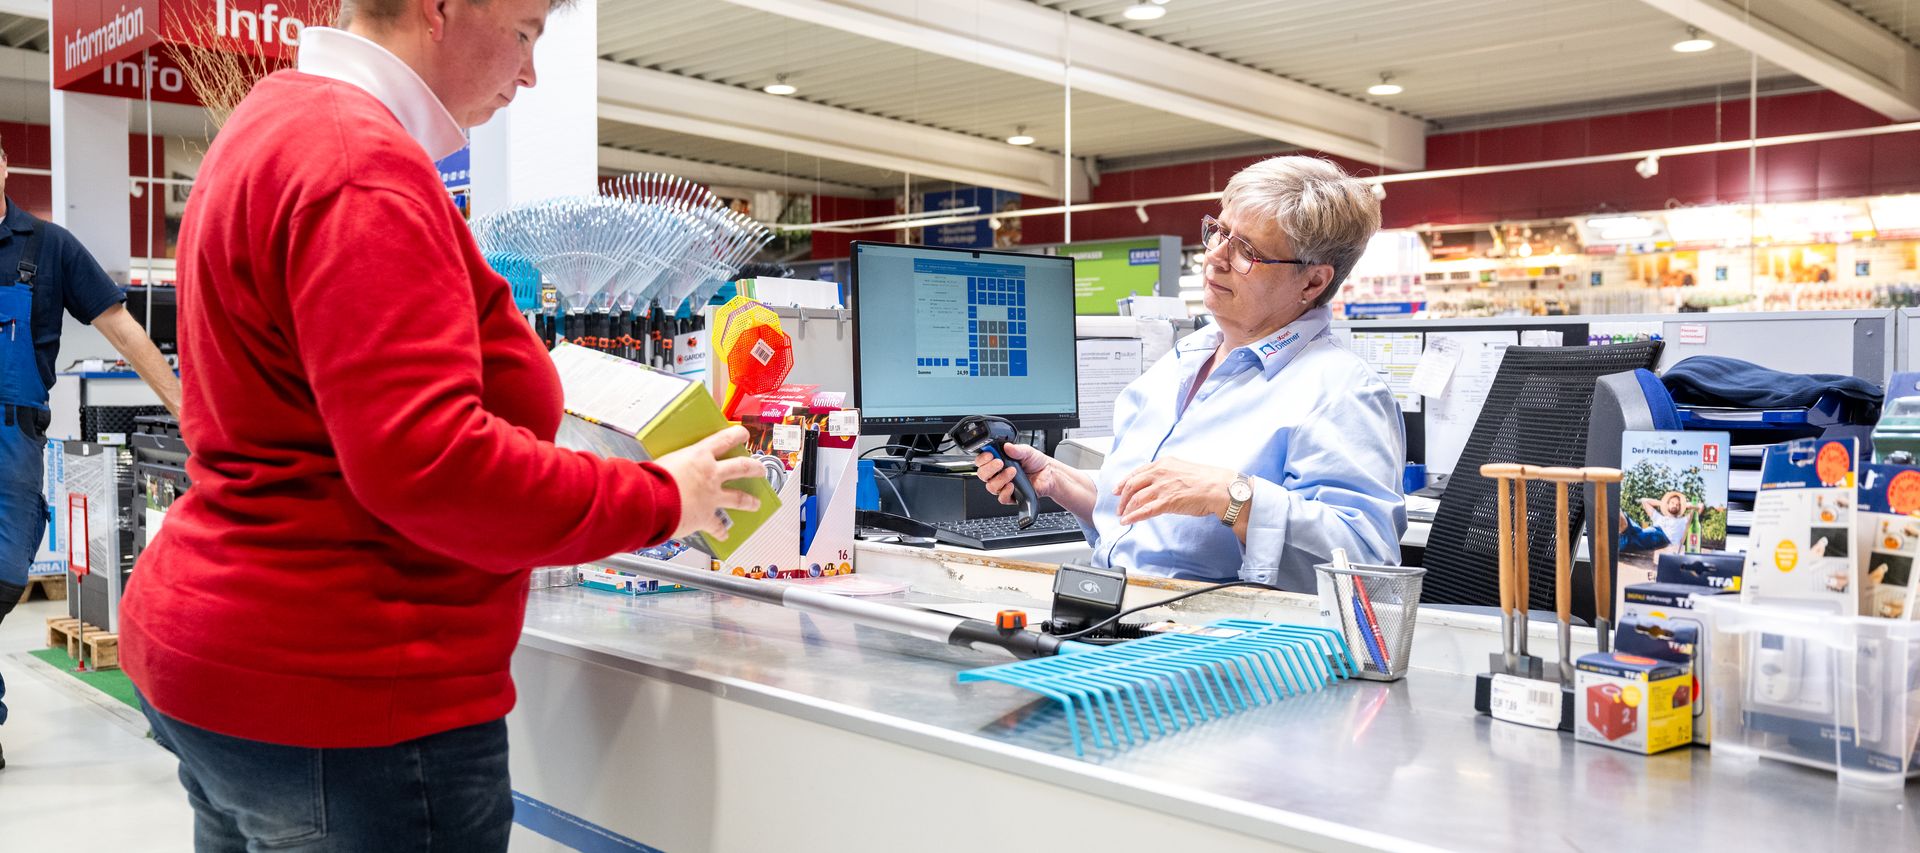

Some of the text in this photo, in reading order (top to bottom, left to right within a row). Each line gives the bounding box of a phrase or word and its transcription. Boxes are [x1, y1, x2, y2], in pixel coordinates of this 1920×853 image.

[216, 0, 304, 46] Info
[65, 3, 144, 71] Information
[103, 56, 183, 92] Info
[1275, 332, 1300, 351] Dittmer
[1646, 447, 1699, 457] Freizeitspaten
[838, 549, 848, 560] 16
[1707, 576, 1734, 587] TFA
